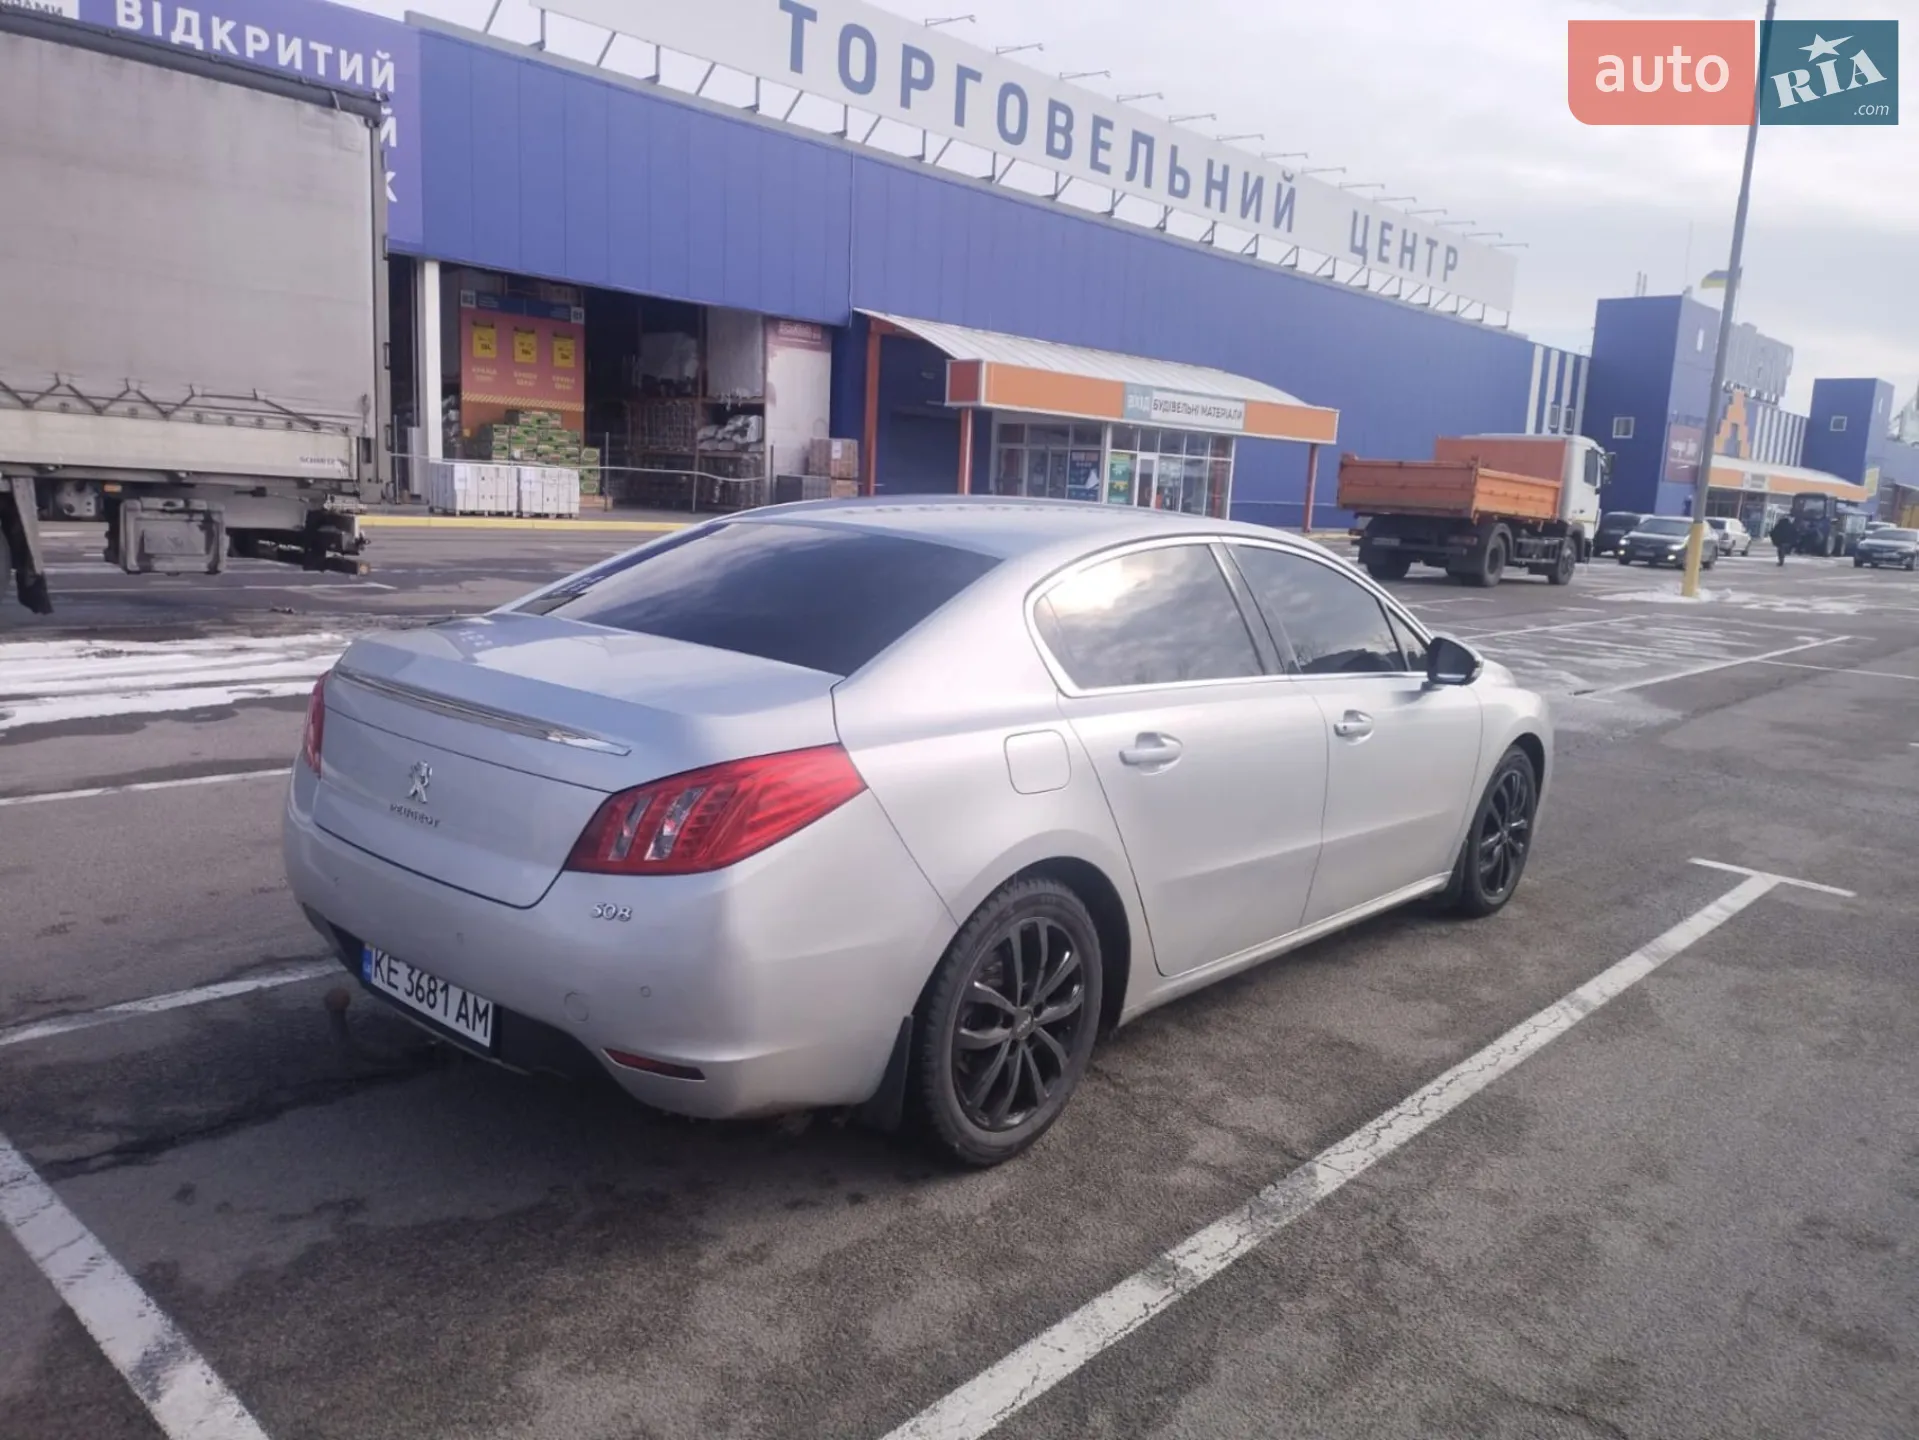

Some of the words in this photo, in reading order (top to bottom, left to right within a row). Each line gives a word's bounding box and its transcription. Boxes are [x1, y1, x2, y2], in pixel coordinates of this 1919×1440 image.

[115, 0, 396, 94] ВІДКРИТИЙ
[778, 0, 1297, 233] ТОРГОВЕЛЬНИЙ
[1349, 208, 1459, 283] ЦЕНТР
[1152, 398, 1199, 416] БУДІВЕЛЬНІ
[1200, 405, 1243, 421] МАТЕРІАЛИ
[390, 804, 440, 828] PEUGEOT
[589, 902, 633, 922] 508
[374, 948, 399, 991] KE
[404, 966, 450, 1018] 3681
[455, 991, 490, 1038] AM
